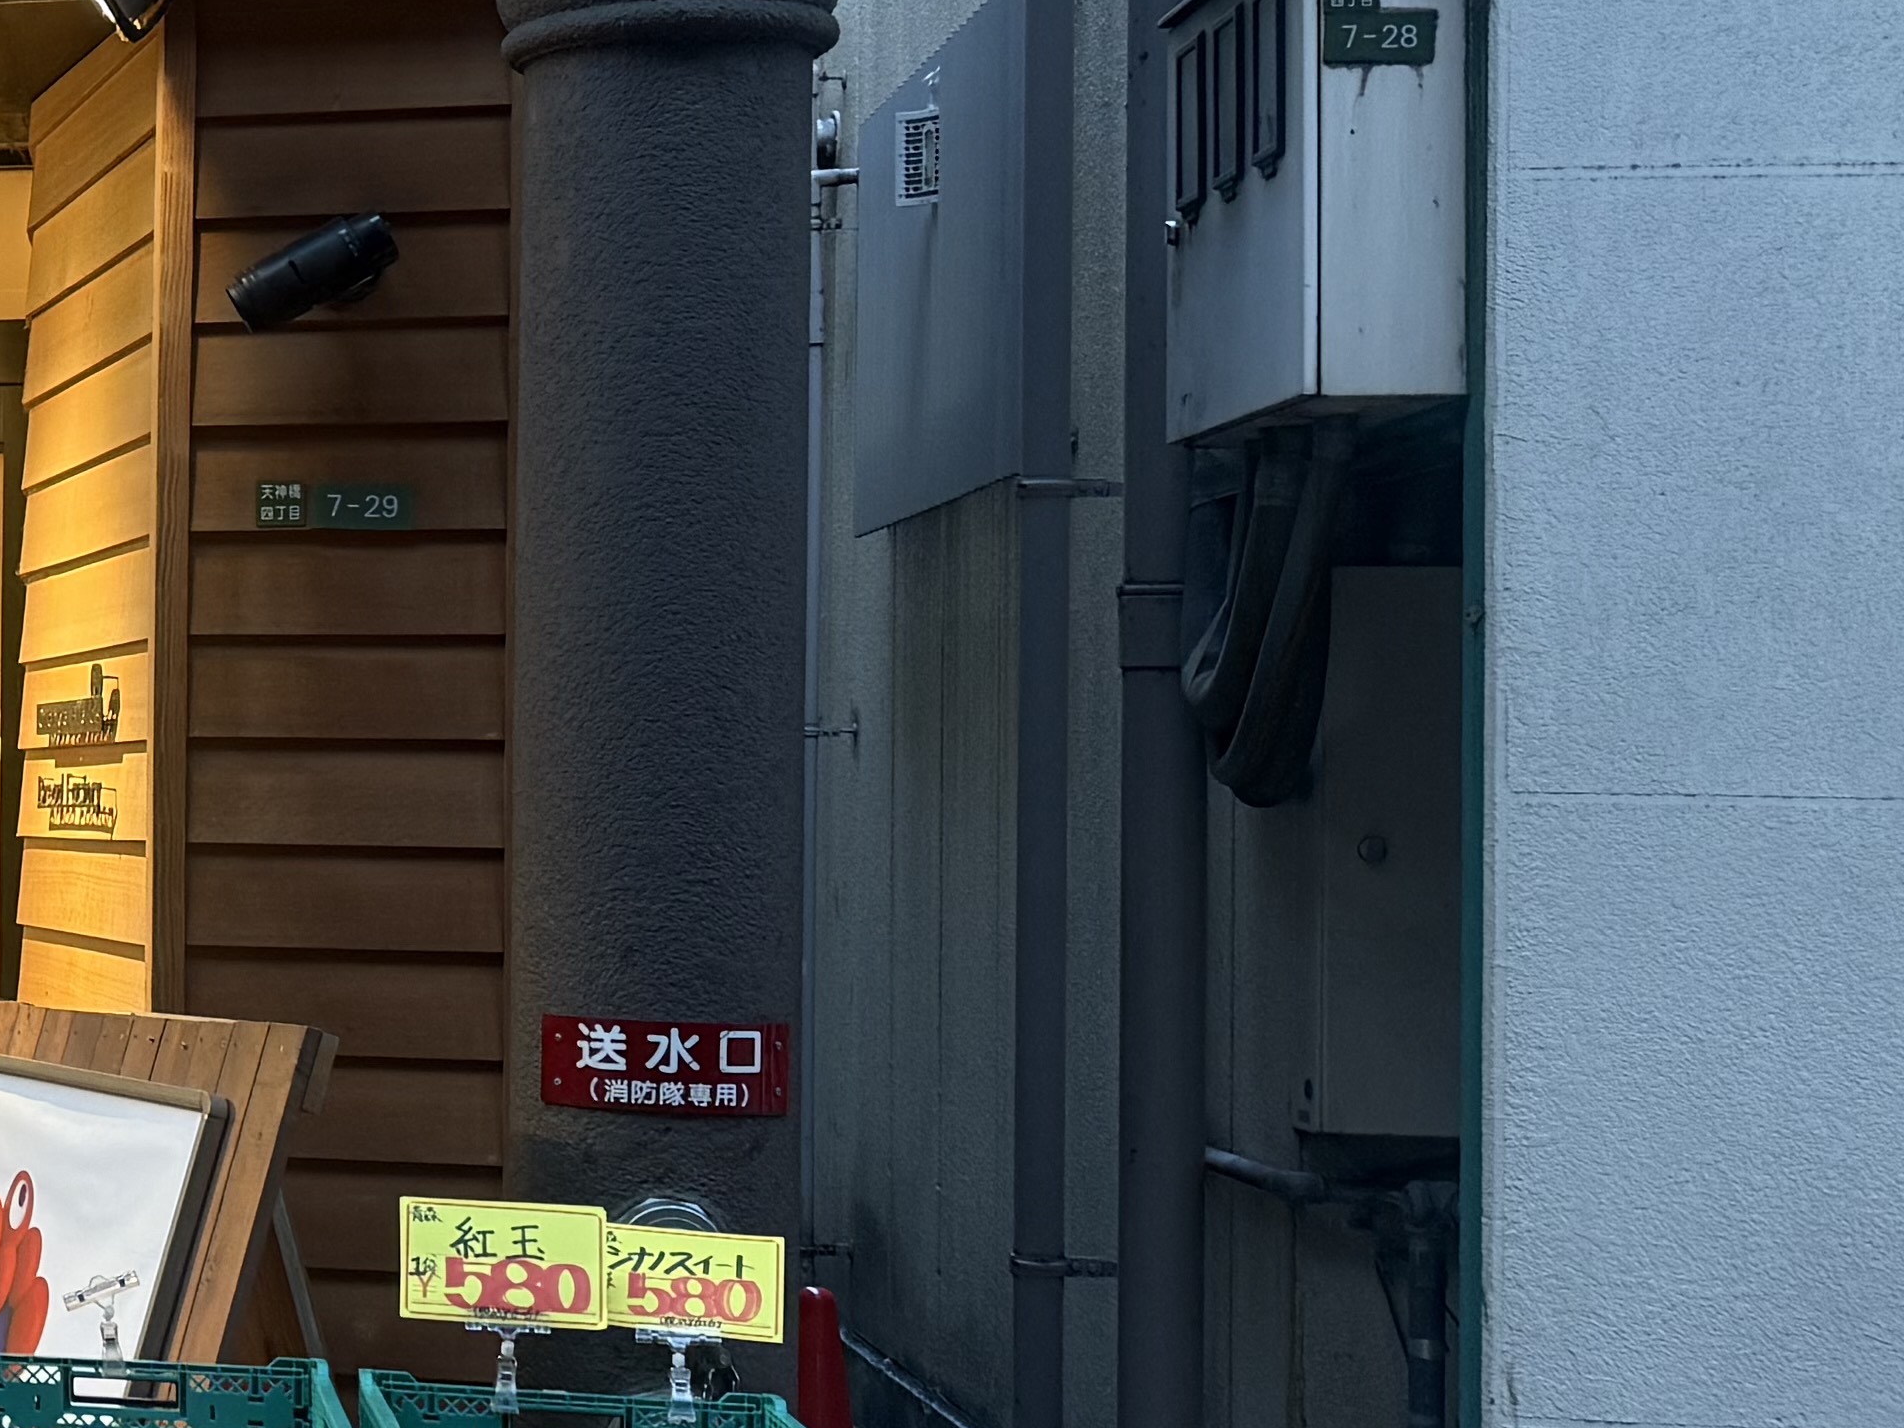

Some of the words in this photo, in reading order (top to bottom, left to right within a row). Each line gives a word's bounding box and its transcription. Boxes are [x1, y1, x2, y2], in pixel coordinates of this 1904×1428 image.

[1341, 24, 1417, 48] 7-28
[260, 484, 301, 500] 天神橋
[327, 494, 398, 518] 7-29
[260, 505, 300, 521] 四丁目
[575, 1022, 763, 1074] 送水口
[449, 1216, 545, 1260] 紅玉
[607, 1245, 755, 1279] シナノスイート
[627, 1271, 763, 1323] 580
